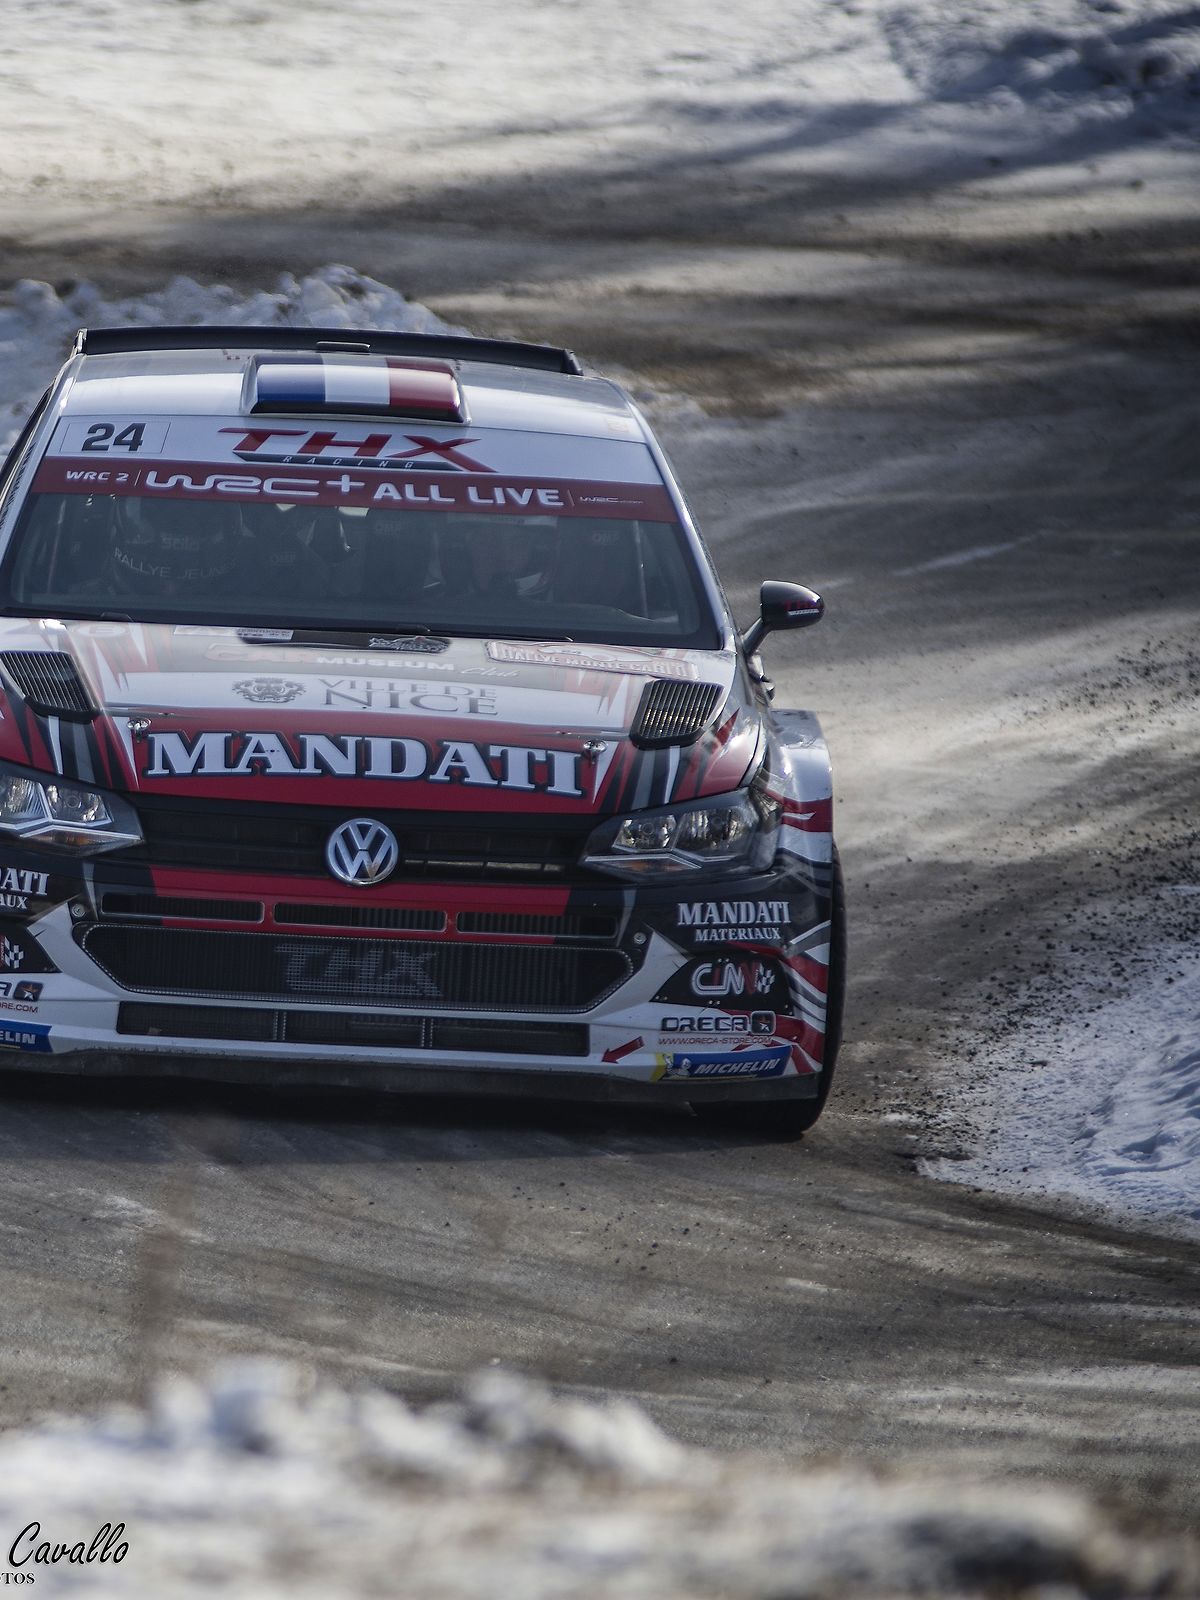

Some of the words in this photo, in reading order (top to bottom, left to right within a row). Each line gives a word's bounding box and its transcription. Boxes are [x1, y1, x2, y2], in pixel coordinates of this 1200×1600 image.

[81, 422, 147, 452] 24
[217, 427, 499, 473] THX
[282, 455, 414, 470] RACING
[66, 470, 111, 482] WRC
[116, 472, 130, 482] 2
[373, 482, 456, 503] ALL
[467, 486, 564, 507] LIVE
[113, 546, 172, 578] RALLYE
[315, 655, 455, 671] MUSEUM
[318, 678, 429, 695] VILLE
[445, 685, 498, 699] DE
[323, 688, 499, 716] NICE
[145, 731, 584, 797] MANDATI
[677, 901, 792, 926] MANDATI
[694, 927, 782, 942] MATERIAUX
[660, 1015, 750, 1033] ORECA
[693, 1057, 781, 1075] MICHELIN
